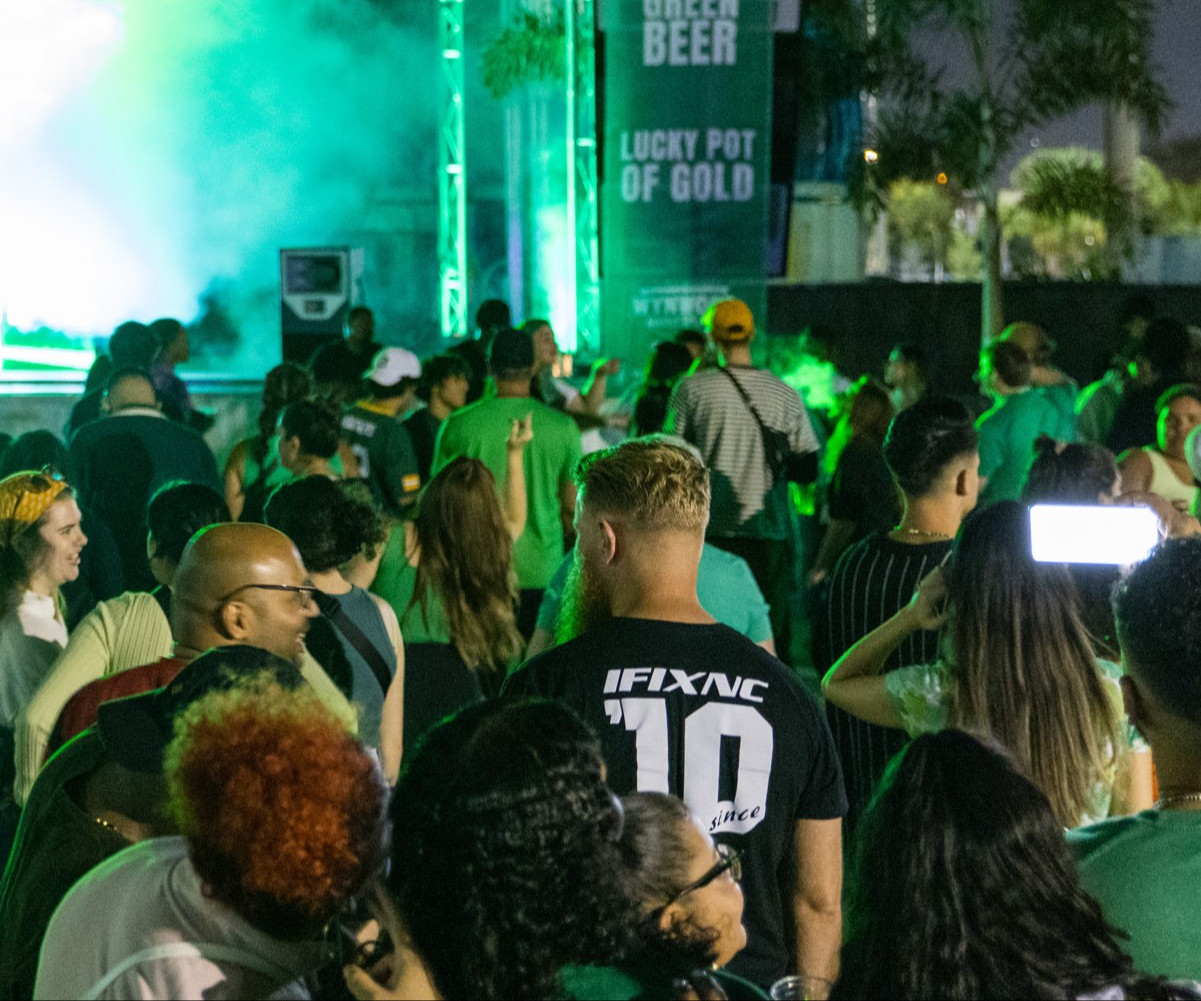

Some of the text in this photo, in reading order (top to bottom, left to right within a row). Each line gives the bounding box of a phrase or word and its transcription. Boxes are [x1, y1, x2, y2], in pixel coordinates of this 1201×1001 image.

[642, 20, 738, 66] BEER
[620, 127, 756, 162] LUCKY POT
[621, 162, 755, 203] OF GOLD
[603, 667, 769, 703] IFIXNC
[709, 804, 761, 832] since
